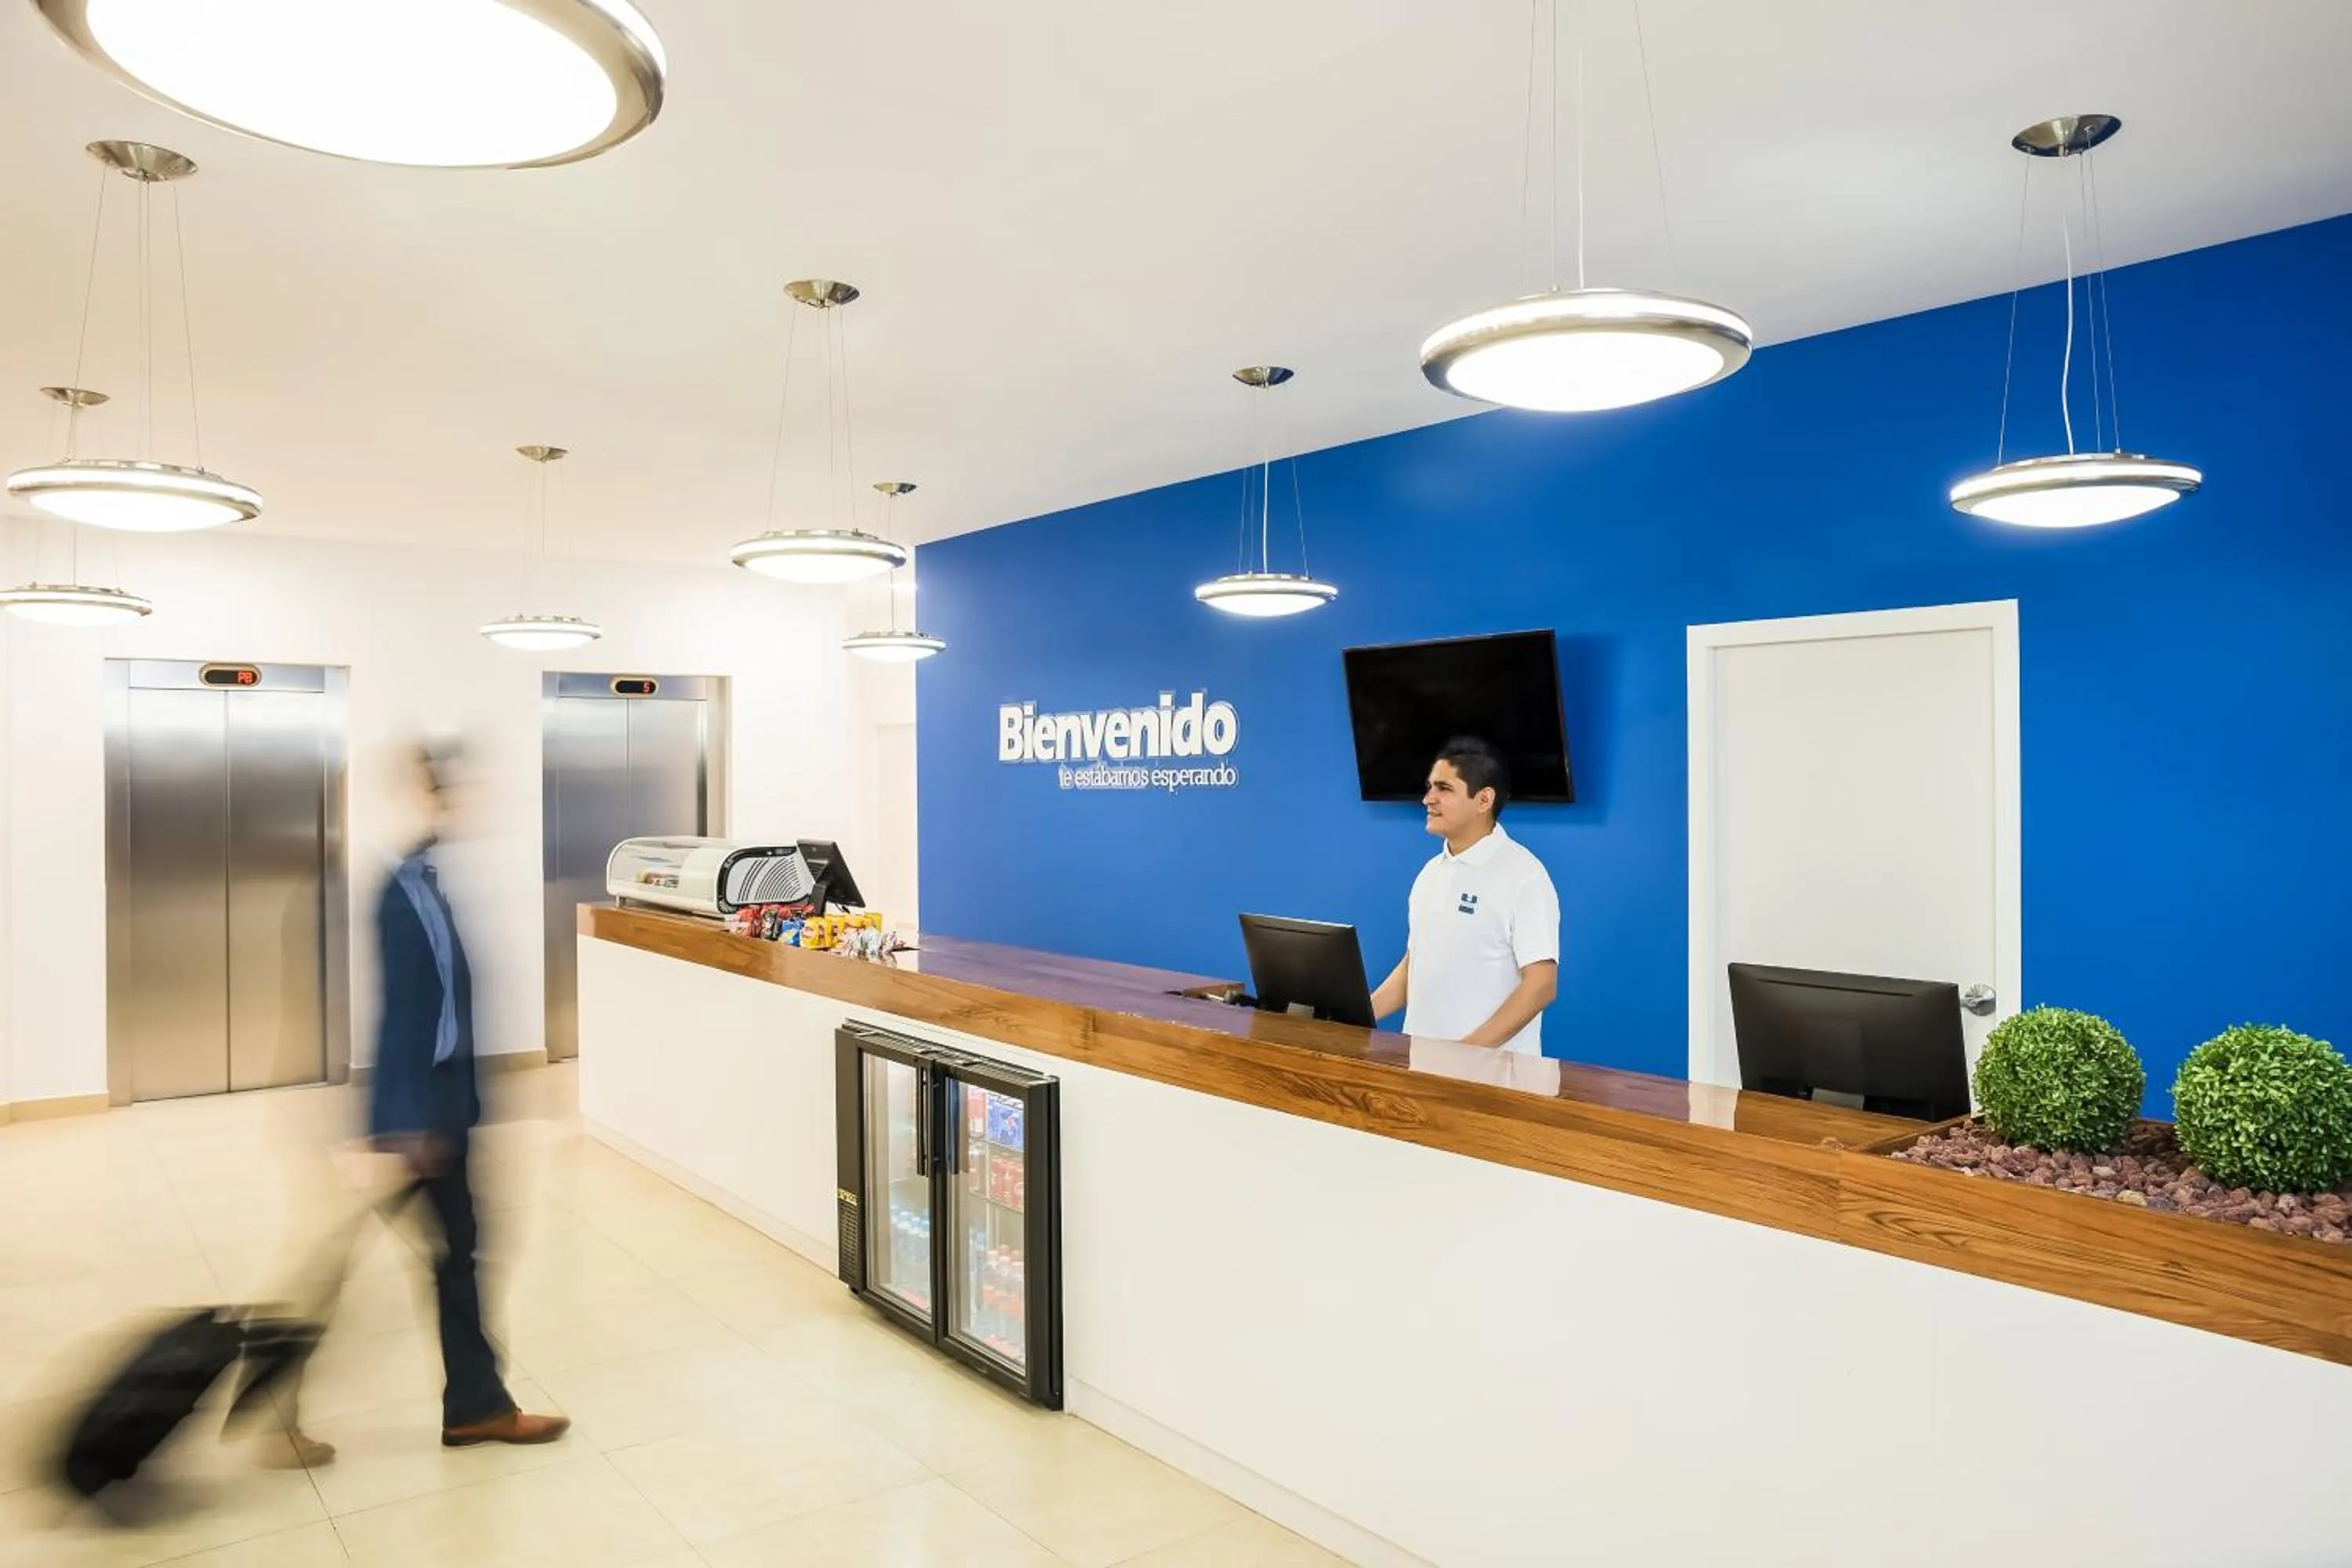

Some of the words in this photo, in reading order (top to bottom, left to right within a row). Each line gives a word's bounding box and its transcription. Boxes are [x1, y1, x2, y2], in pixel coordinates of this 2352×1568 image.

[998, 690, 1238, 761] Bienvenido
[1058, 766, 1072, 786] te
[1152, 763, 1236, 792] esperando
